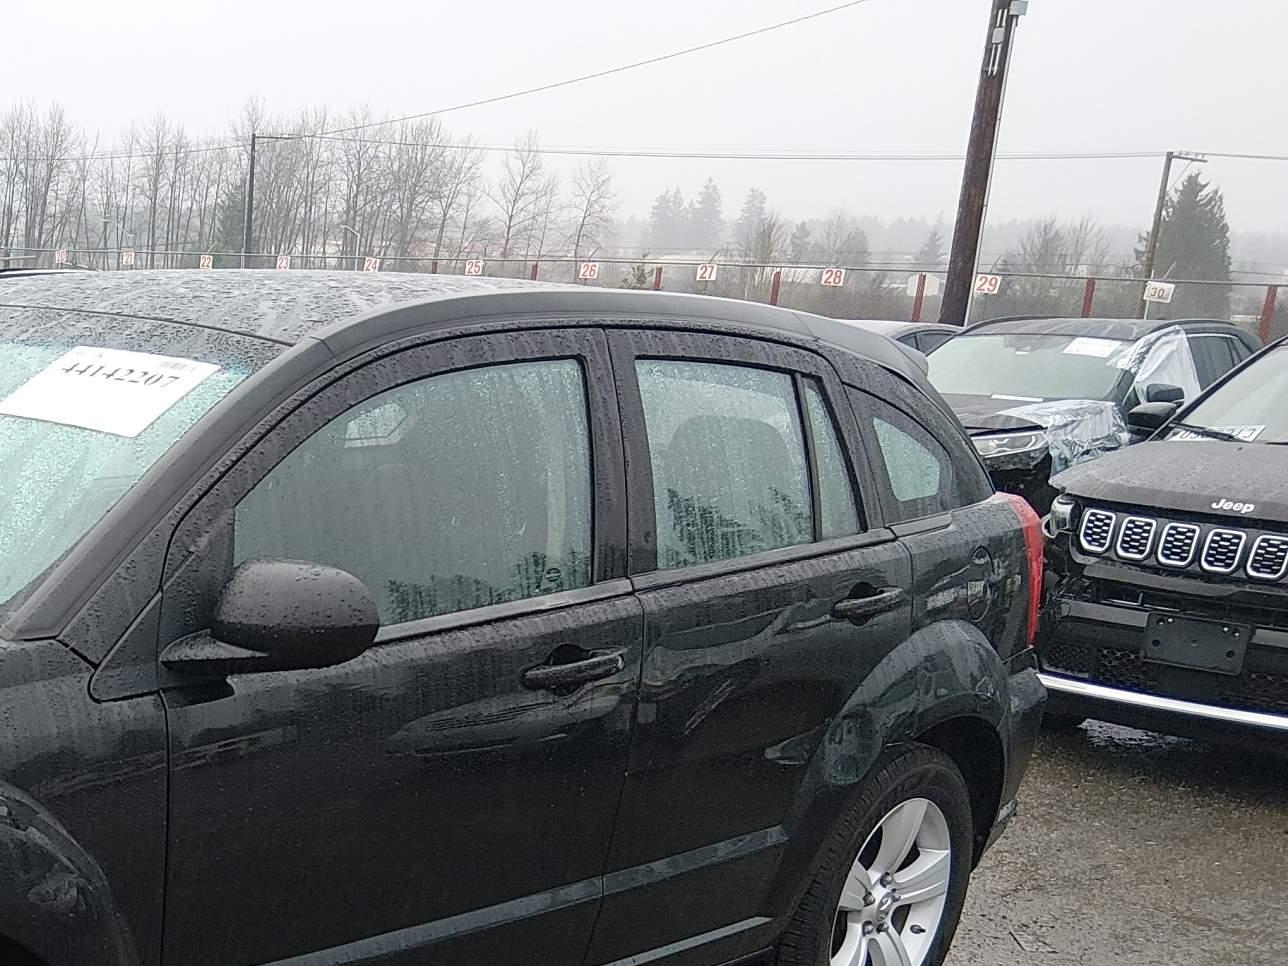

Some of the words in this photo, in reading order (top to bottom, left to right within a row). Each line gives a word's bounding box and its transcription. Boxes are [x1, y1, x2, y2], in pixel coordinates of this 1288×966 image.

[125, 252, 134, 264] 21
[200, 256, 211, 268] 22
[278, 257, 289, 269] 23
[365, 258, 377, 272] 24
[466, 260, 481, 274] 25
[581, 263, 596, 278] 26
[698, 265, 714, 280] 27
[823, 269, 842, 285] 28
[977, 276, 998, 292] 29
[1149, 287, 1165, 298] 30
[61, 362, 180, 388] 44142207
[1211, 498, 1255, 513] Jeep
